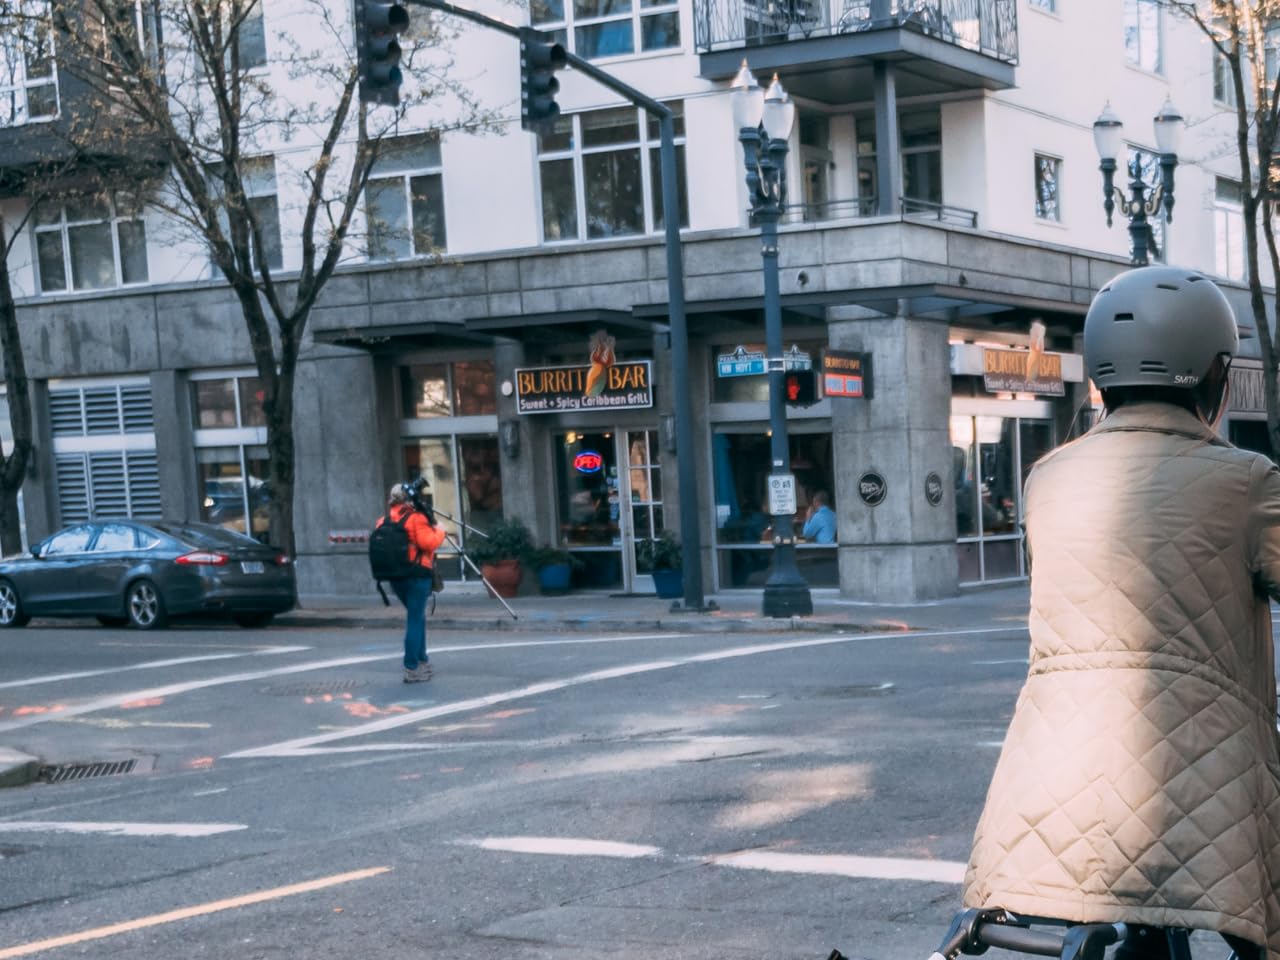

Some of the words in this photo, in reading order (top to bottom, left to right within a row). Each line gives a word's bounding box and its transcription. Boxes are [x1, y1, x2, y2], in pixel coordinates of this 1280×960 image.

[608, 365, 648, 390] BAR
[1173, 375, 1199, 385] SMITH
[520, 398, 548, 410] Sweet
[557, 396, 580, 409] Spicy
[581, 394, 626, 407] Caribbean
[627, 392, 649, 404] Grill
[574, 454, 602, 469] OPEN
